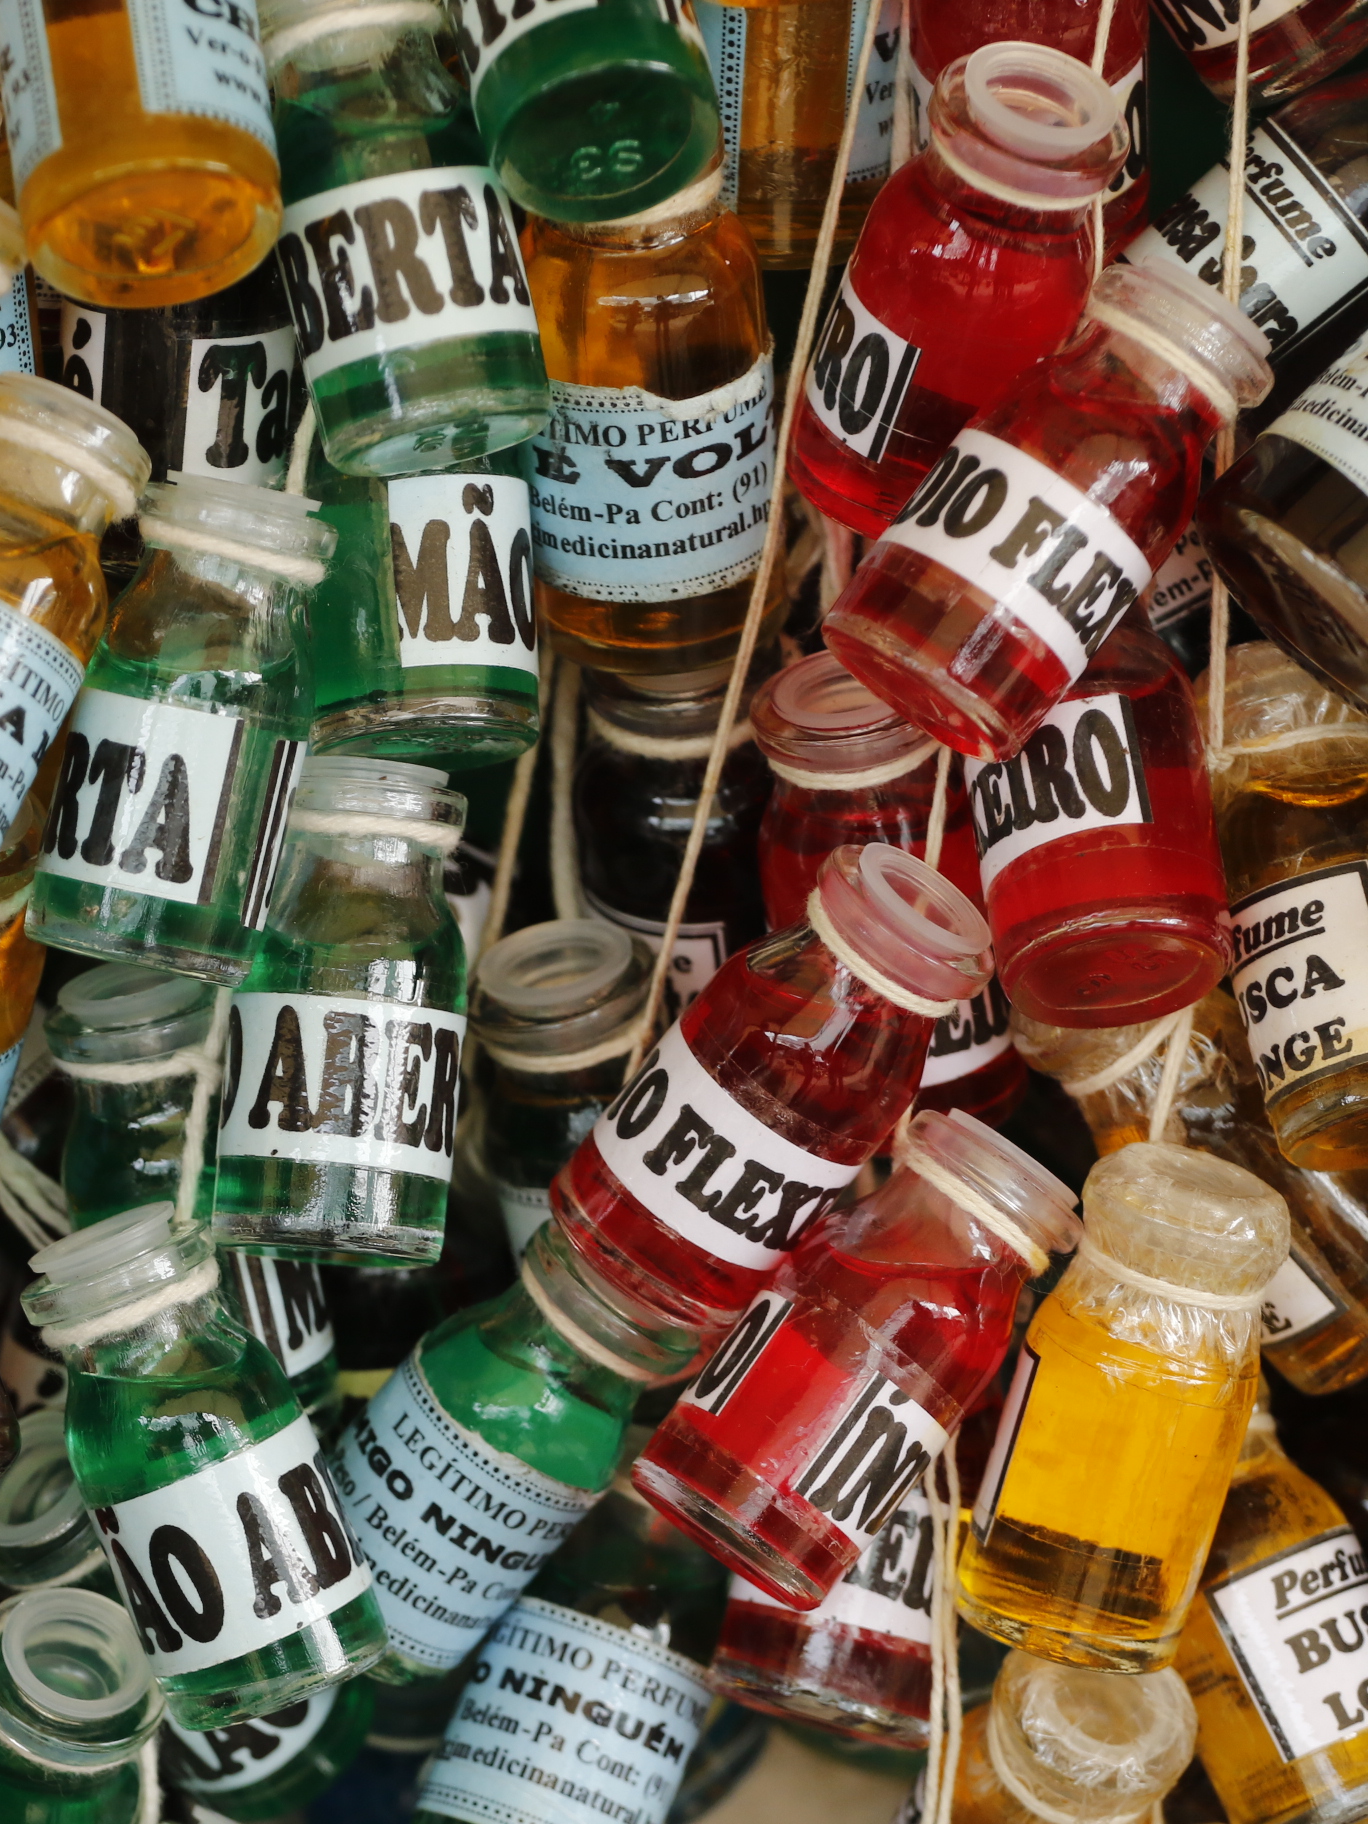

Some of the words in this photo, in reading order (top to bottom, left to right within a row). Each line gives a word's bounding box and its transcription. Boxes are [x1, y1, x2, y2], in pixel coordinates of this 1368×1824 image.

[650, 490, 724, 523] Cont:
[731, 460, 769, 504] (91)
[391, 1411, 528, 1530] LEGÍTIMO
[364, 1501, 478, 1595] Belém-Pa
